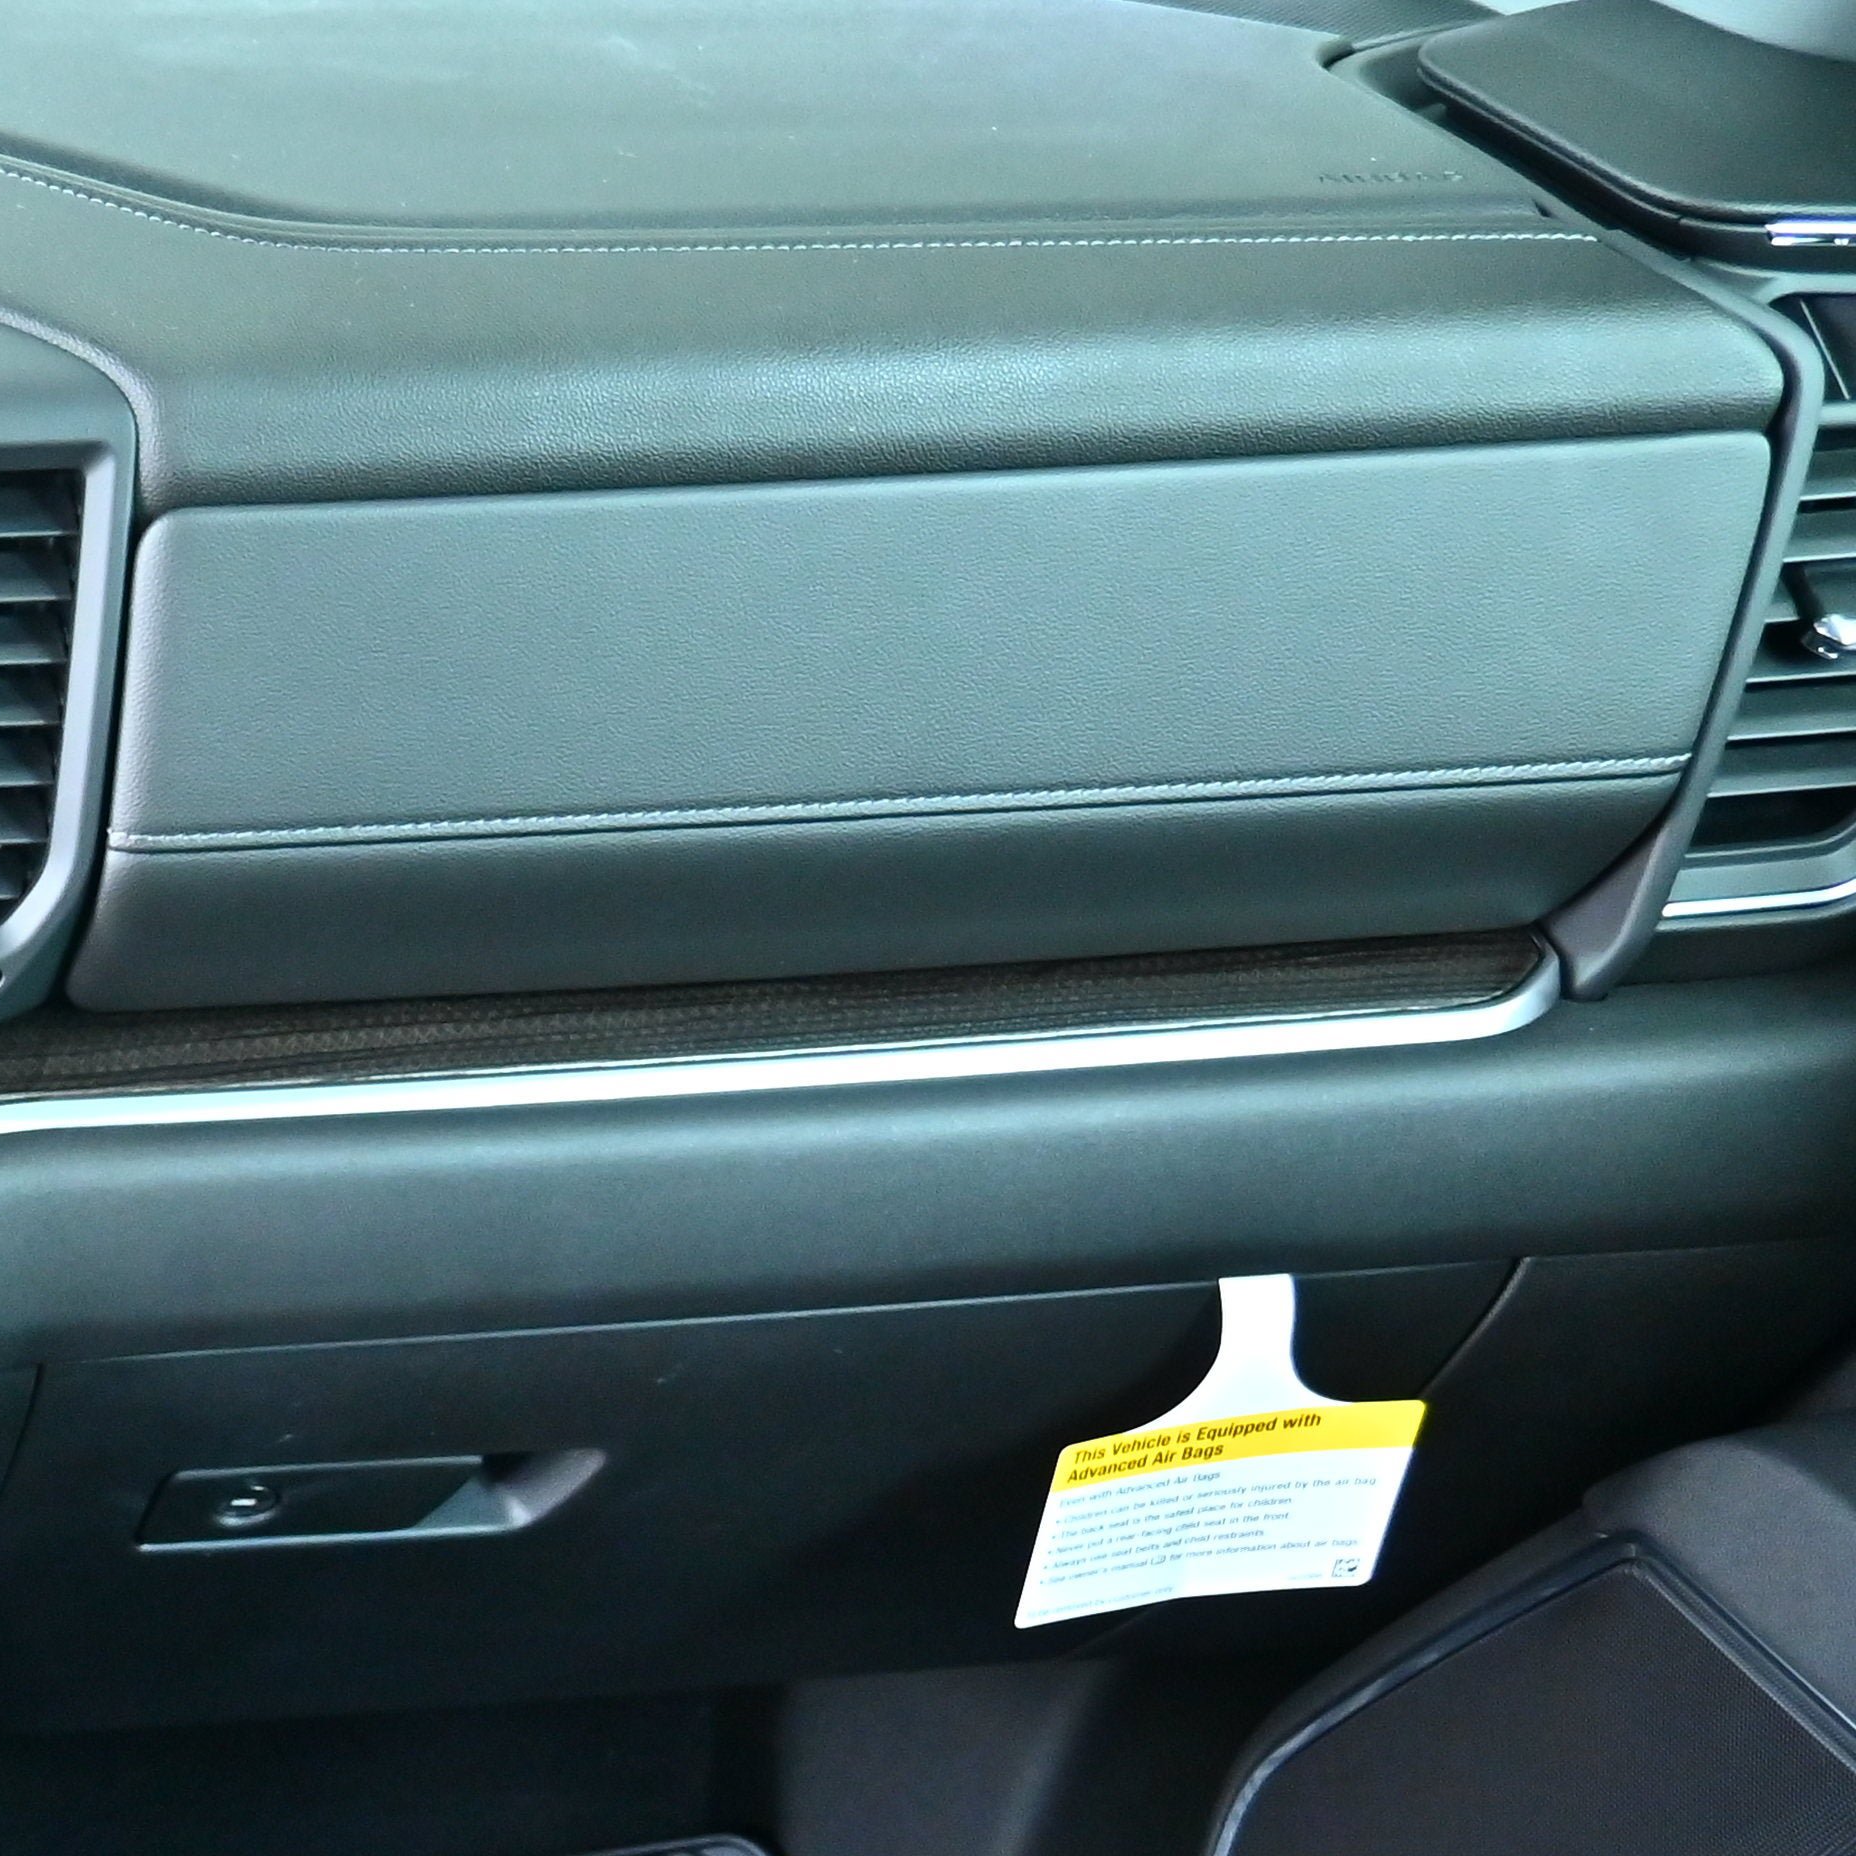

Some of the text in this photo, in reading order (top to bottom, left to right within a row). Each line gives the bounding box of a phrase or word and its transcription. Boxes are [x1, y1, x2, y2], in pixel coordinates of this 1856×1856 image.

[1075, 1413, 1322, 1465] This Vehicle is Equipped with
[1067, 1444, 1225, 1484] Advanced Air Bags
[1116, 1479, 1170, 1495] Advanced
[1197, 1487, 1247, 1499] seriously
[1251, 1481, 1291, 1493] injured
[1295, 1480, 1310, 1491] by
[1312, 1479, 1331, 1489] the
[1230, 1501, 1244, 1509] for
